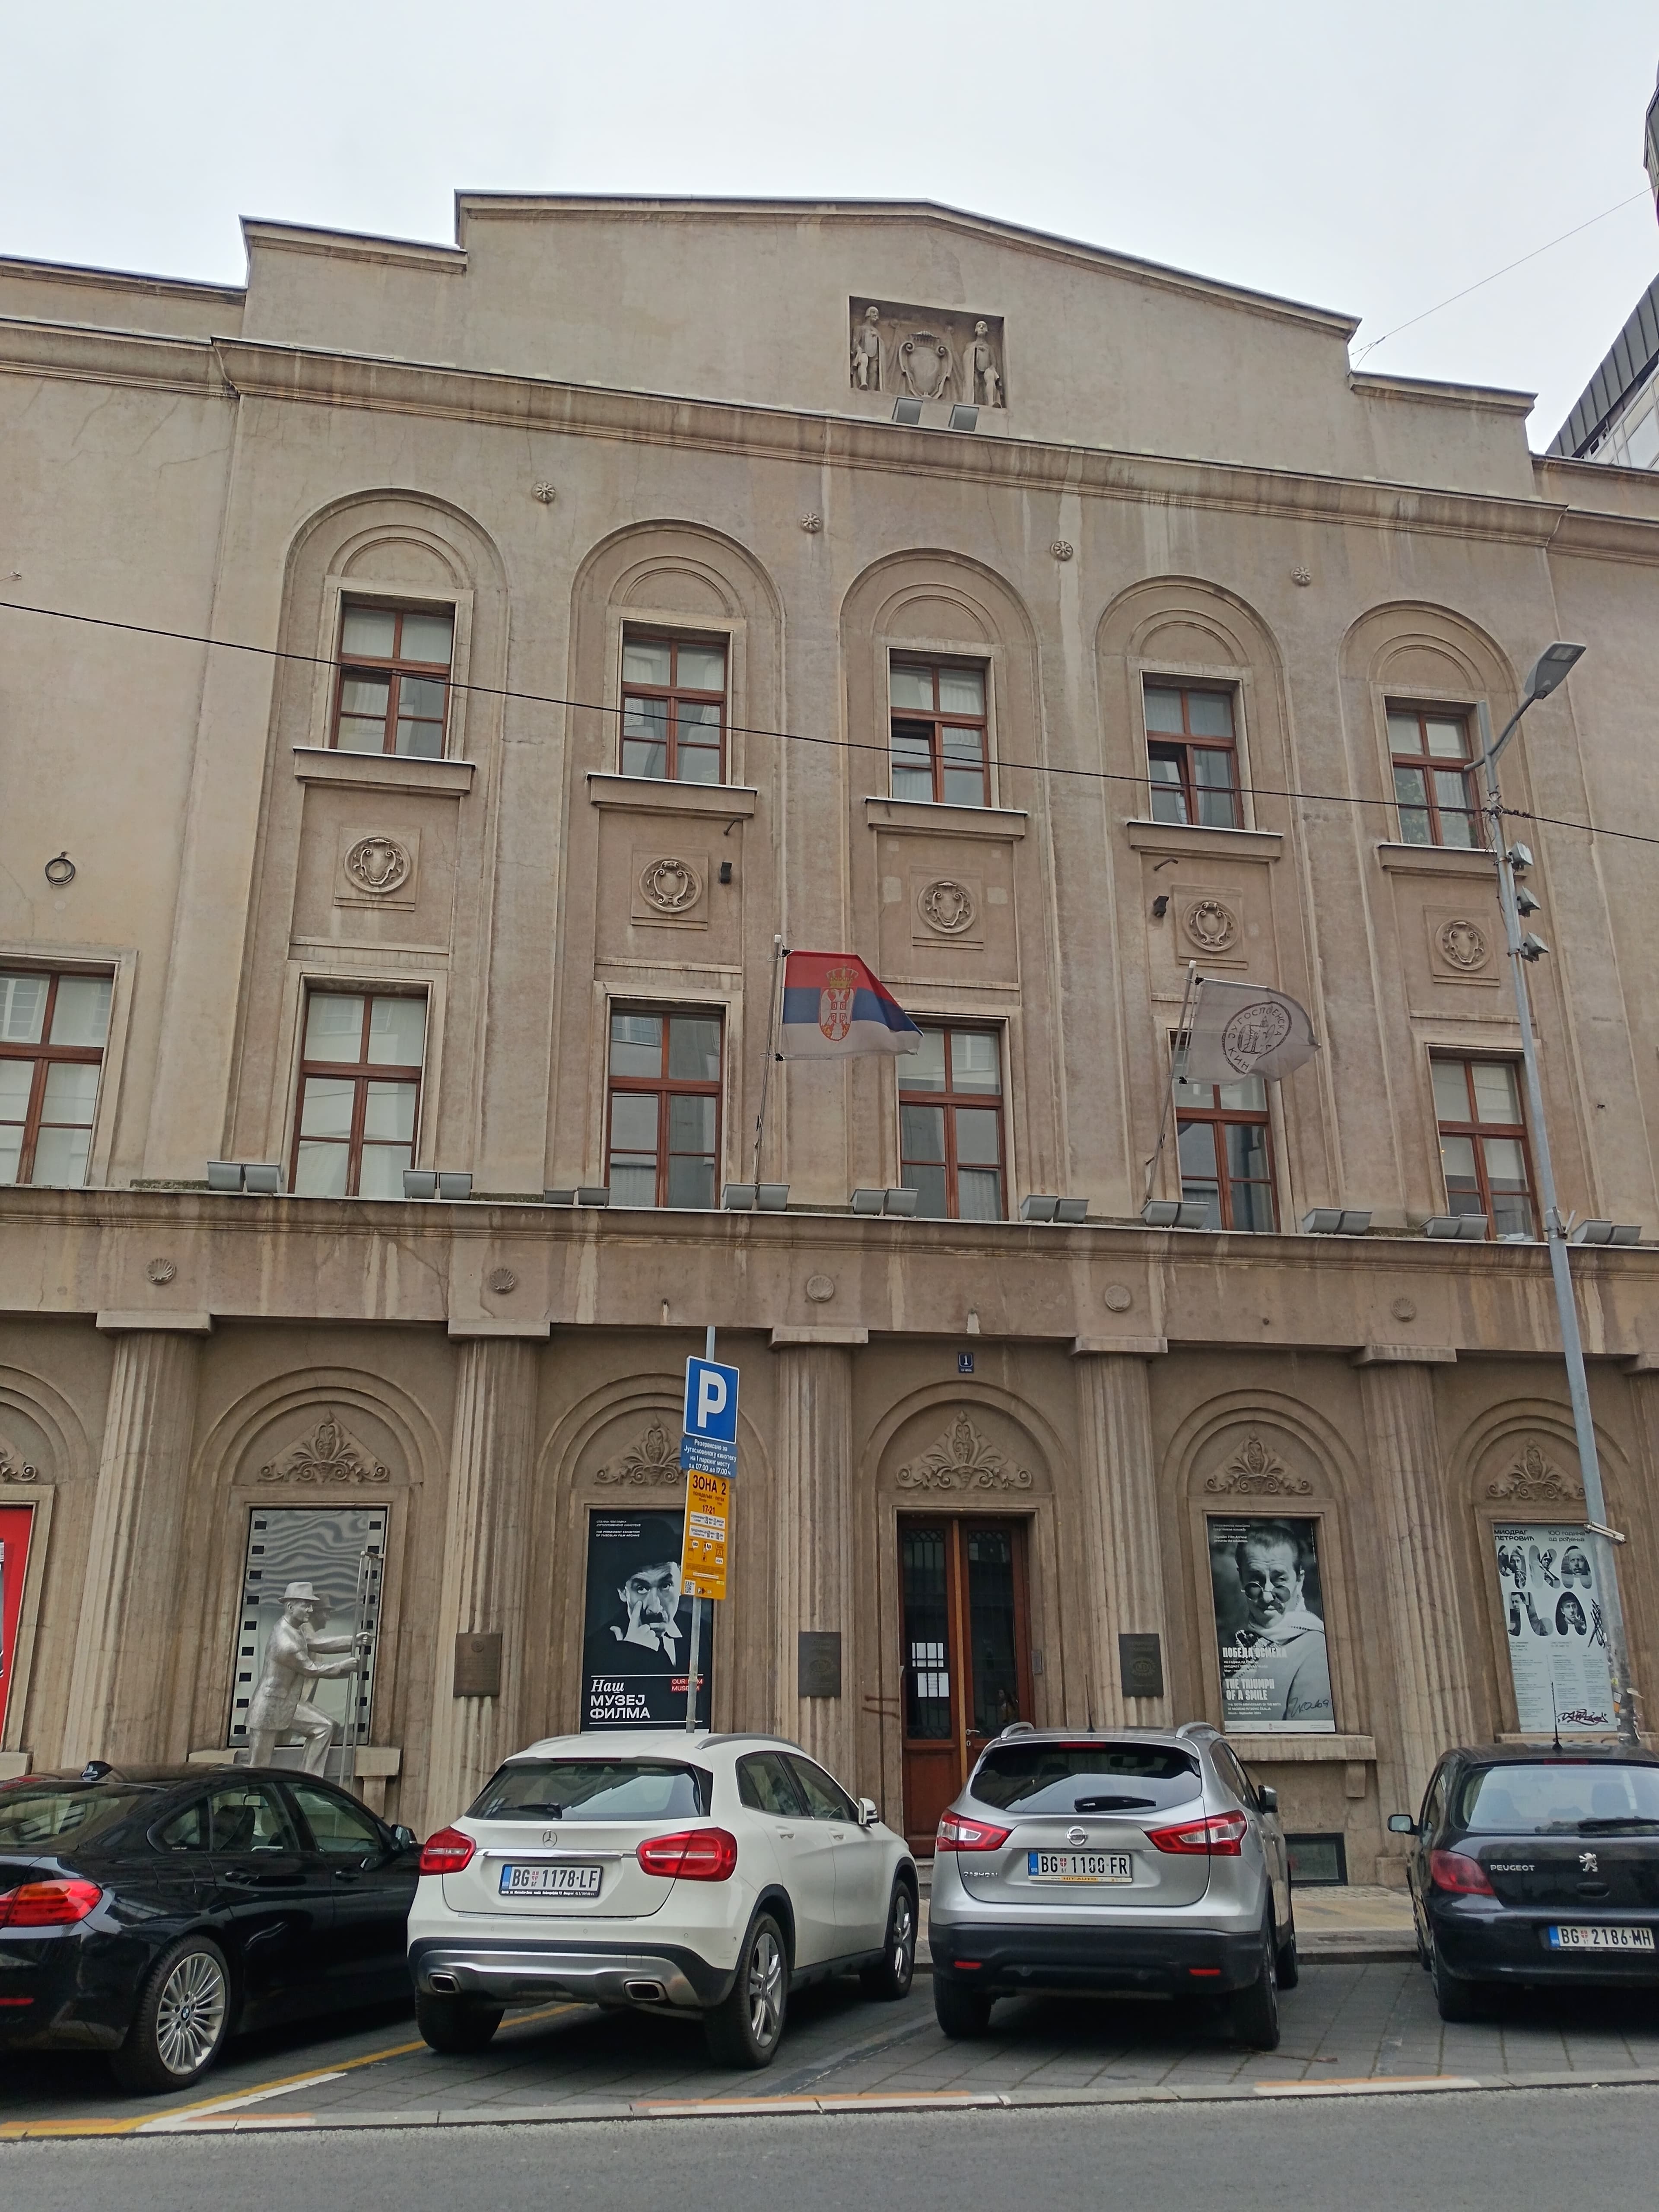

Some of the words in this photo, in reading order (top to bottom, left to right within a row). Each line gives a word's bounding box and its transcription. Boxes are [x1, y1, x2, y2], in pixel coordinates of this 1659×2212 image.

[964, 1355, 969, 1365] 1
[697, 1369, 727, 1428] P
[684, 1445, 716, 1459] Југословенску
[717, 1461, 730, 1469] месту
[693, 1475, 717, 1493] ЗОНА
[721, 1482, 726, 1495] 2
[1222, 1647, 1253, 1658] ПОБЕДА
[590, 1679, 624, 1693] Наш
[1225, 1678, 1239, 1689] THE
[1241, 1678, 1274, 1689] TRIUMPH
[591, 1694, 645, 1706] МУЗЕЈ
[1226, 1690, 1236, 1700] OF
[1238, 1690, 1243, 1700] A
[1245, 1690, 1268, 1700] SMILE
[589, 1707, 651, 1719] ФИЛМА
[1041, 1856, 1058, 1873] BG
[512, 1869, 530, 1887] BG
[1561, 1928, 1580, 1944] BG
